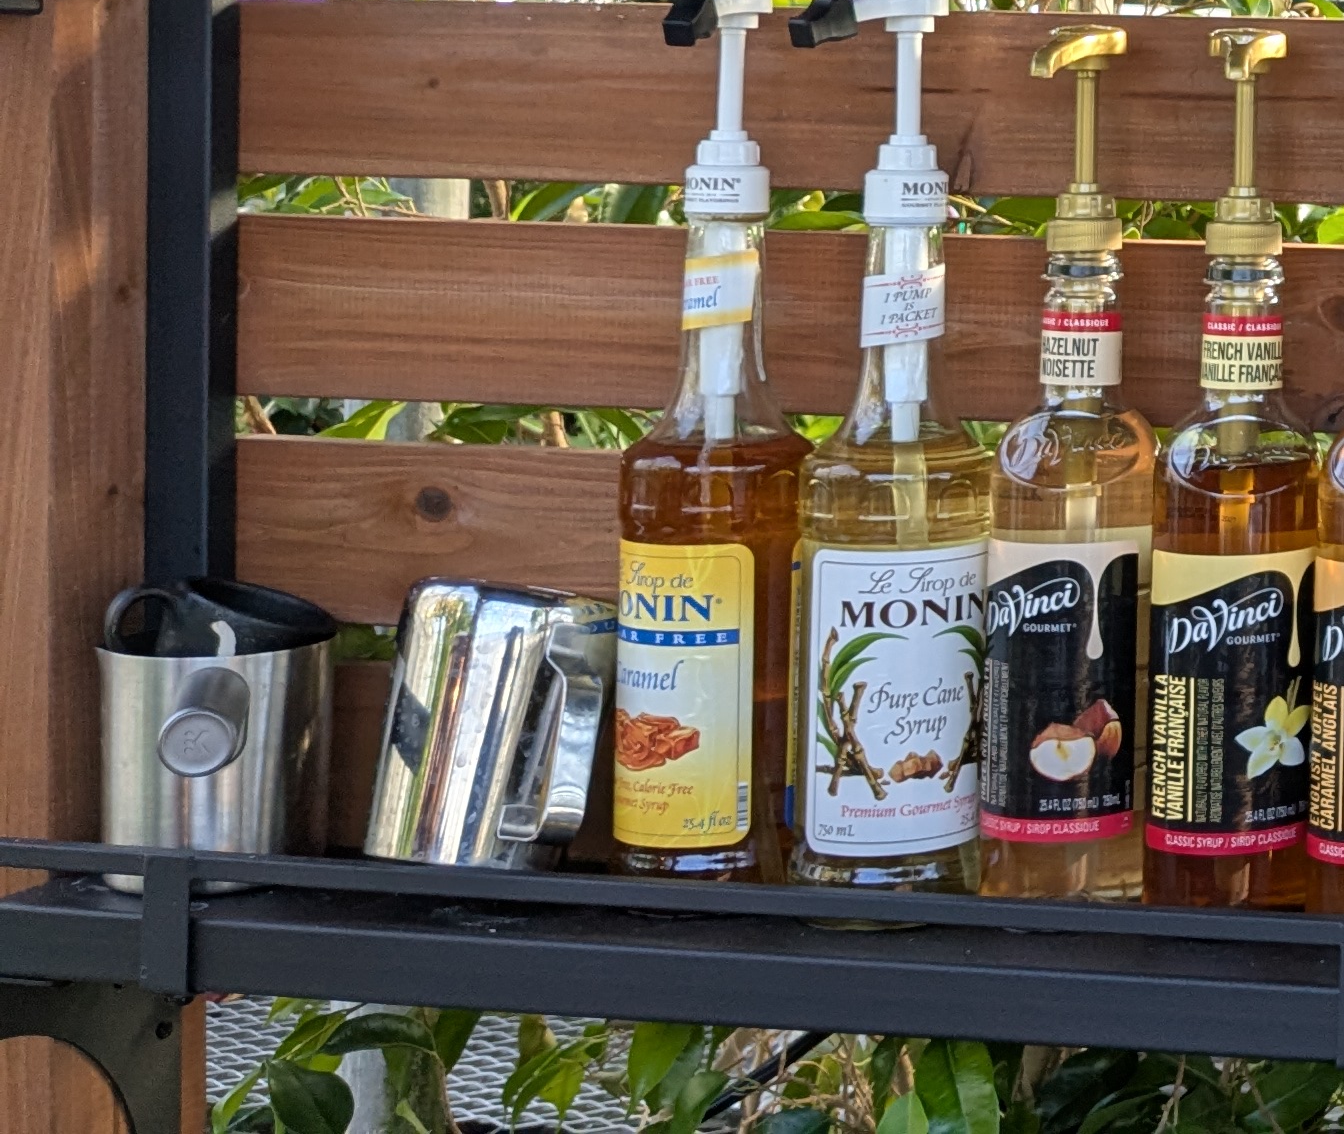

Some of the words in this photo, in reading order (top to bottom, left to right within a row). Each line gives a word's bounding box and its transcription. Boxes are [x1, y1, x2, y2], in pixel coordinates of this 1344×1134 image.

[893, 288, 932, 302] PUMP
[904, 302, 915, 311] IS
[888, 307, 938, 324] PACKET
[1204, 340, 1243, 361] FRENCH
[671, 574, 693, 588] de
[859, 569, 895, 595] Le
[899, 567, 956, 597] Sirop
[959, 571, 977, 587] de
[840, 589, 992, 629] MONIN
[986, 577, 1080, 637] DaVinci
[1168, 587, 1284, 654] DaVinci
[655, 633, 728, 644] FREE
[1022, 623, 1073, 633] GOURMET
[1226, 633, 1277, 646] GOURMET
[867, 682, 918, 714] Pure
[922, 677, 964, 704] Cane
[1153, 674, 1169, 745] VANILLA
[884, 707, 948, 745] Syrup
[1322, 684, 1338, 753] ANGLAIS
[1152, 750, 1167, 818] FRENCH
[1166, 760, 1186, 821] VANILLE
[1309, 751, 1322, 827] ENGLISH
[1320, 756, 1337, 830] CARAMEL
[841, 804, 896, 818] Premium
[900, 800, 951, 817] Gourmet
